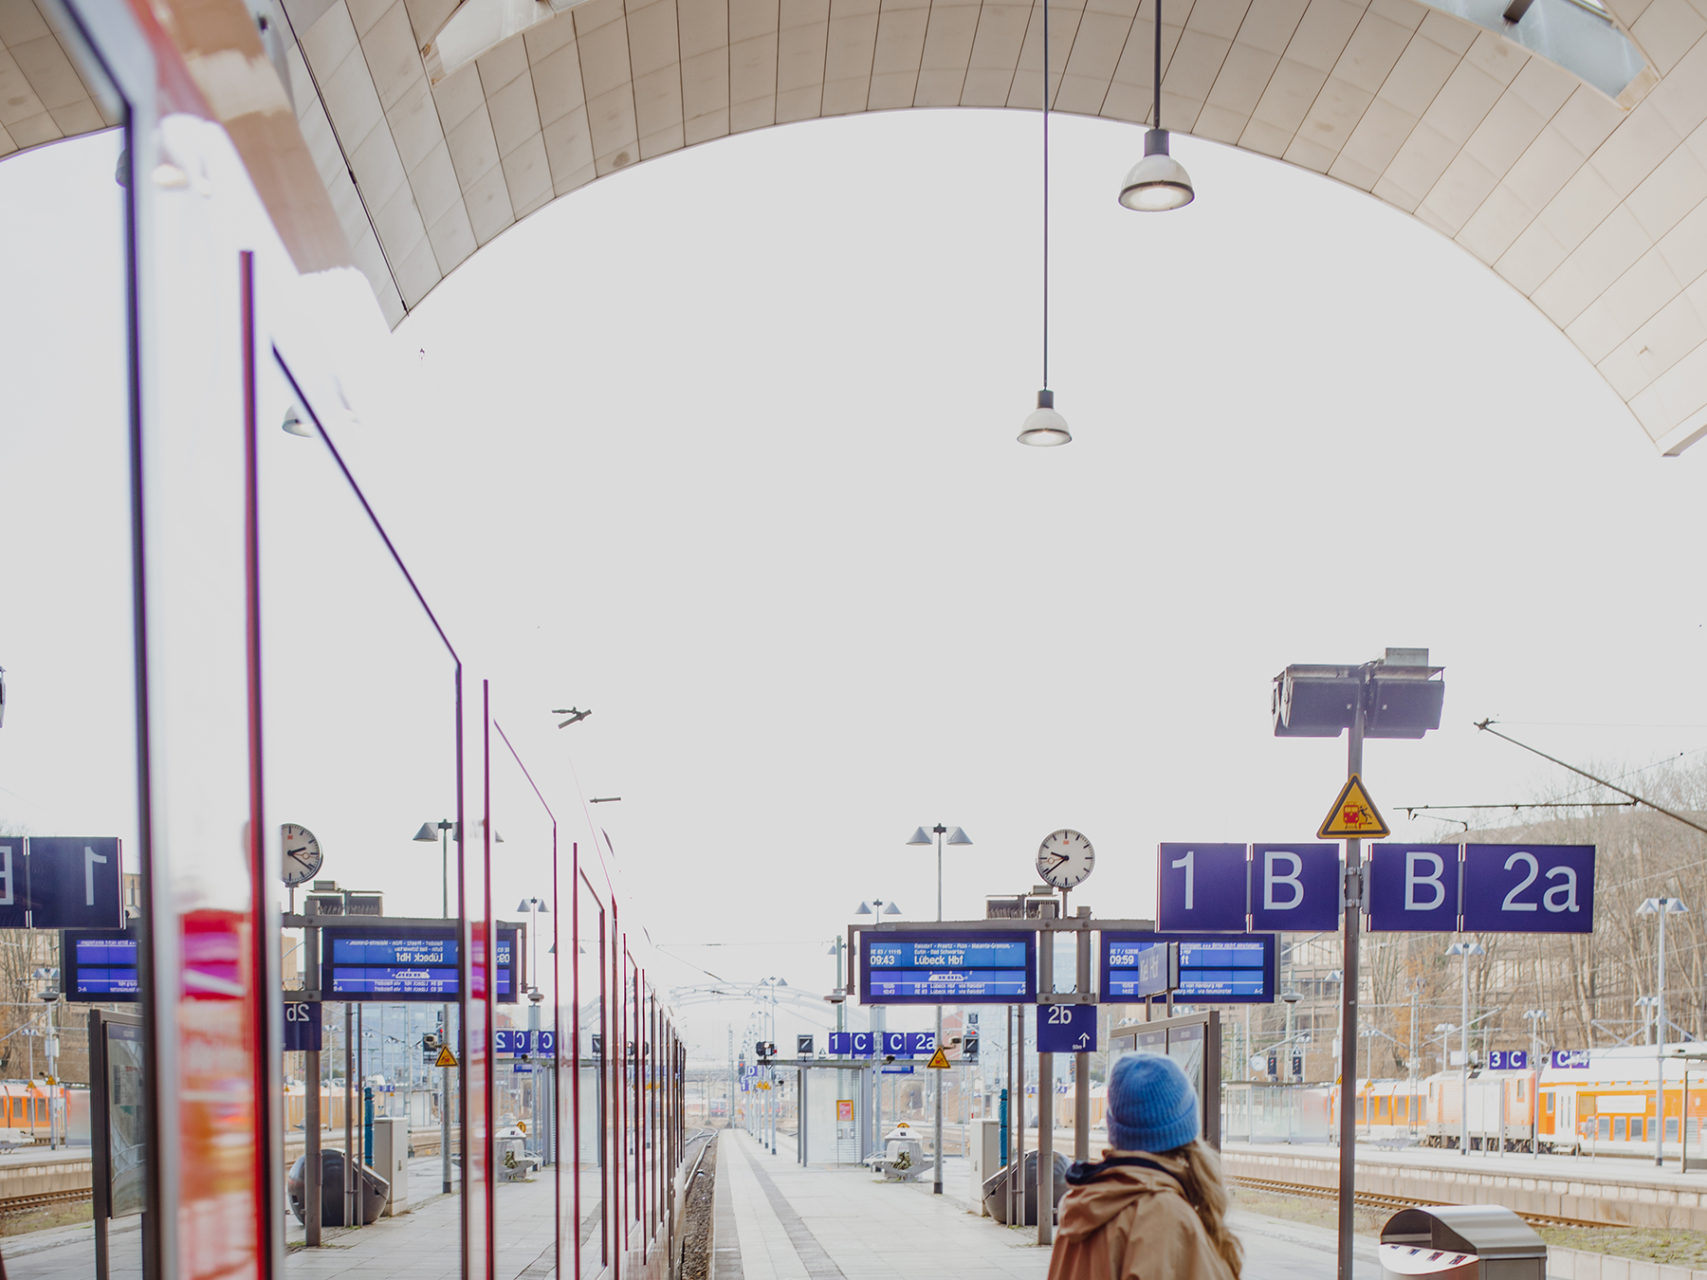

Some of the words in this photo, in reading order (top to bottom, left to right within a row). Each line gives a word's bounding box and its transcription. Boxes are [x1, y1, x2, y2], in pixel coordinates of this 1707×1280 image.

[1171, 851, 1194, 910] 1
[1263, 851, 1304, 910] B
[1404, 852, 1446, 911] B
[1501, 851, 1580, 913] 2a
[870, 955, 895, 965] 09:43
[914, 955, 945, 965] Lübeck
[948, 955, 964, 965] Hbf
[1110, 955, 1134, 965] 09:59
[1047, 1005, 1072, 1025] 2b
[831, 1034, 838, 1050] 1
[854, 1034, 867, 1050] C
[890, 1034, 903, 1050] C
[915, 1034, 936, 1050] 2a
[1491, 1051, 1501, 1067] 3
[1510, 1051, 1522, 1067] C
